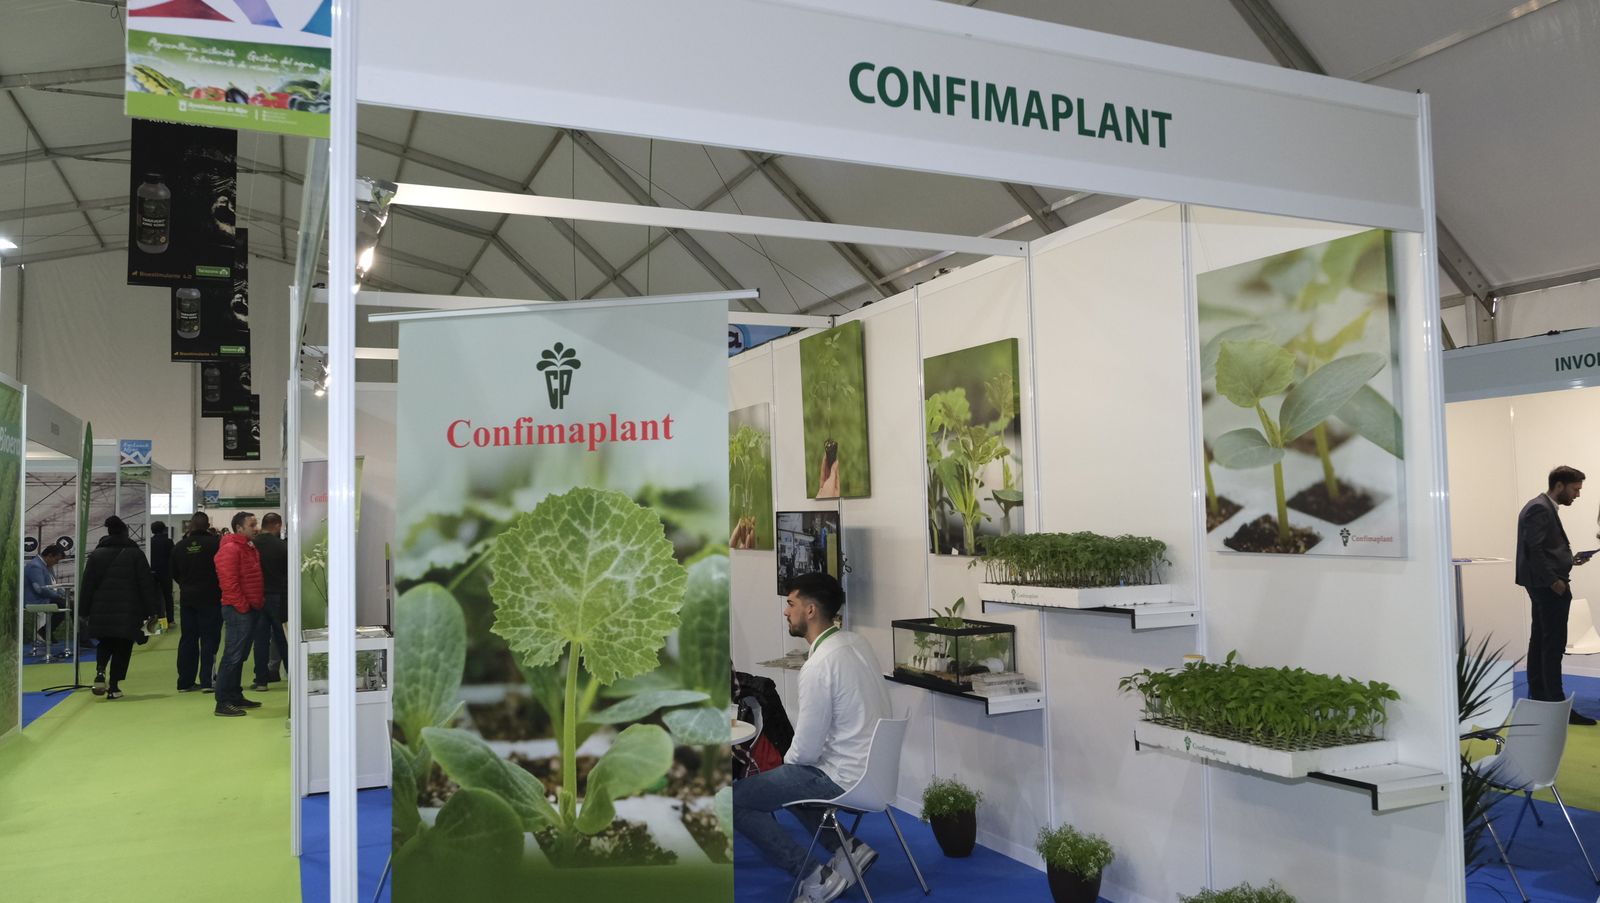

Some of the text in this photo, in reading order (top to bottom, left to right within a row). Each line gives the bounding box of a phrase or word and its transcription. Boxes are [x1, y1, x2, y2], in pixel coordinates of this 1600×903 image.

[848, 61, 1173, 149] CONFIMAPLANT
[446, 411, 675, 452] Confimaplant
[1351, 535, 1393, 545] Confimaplant
